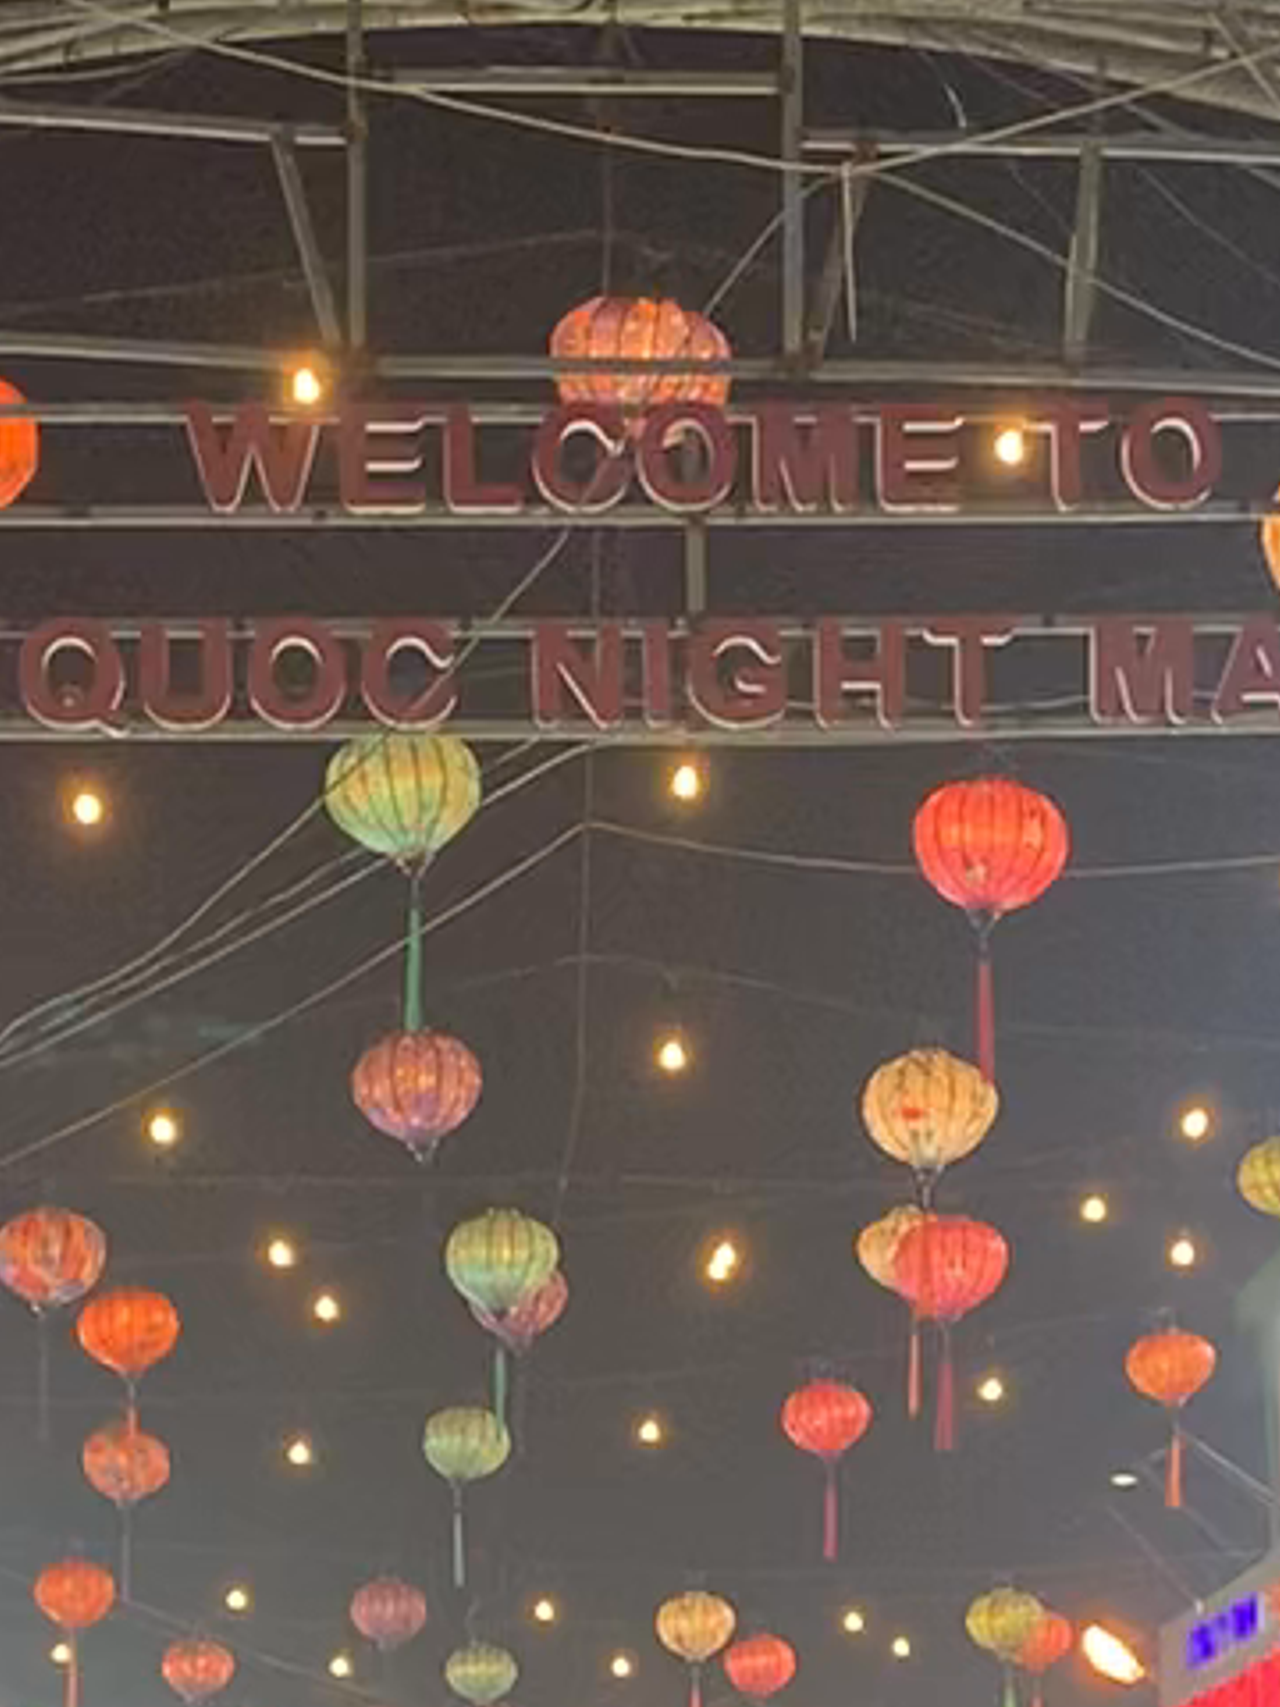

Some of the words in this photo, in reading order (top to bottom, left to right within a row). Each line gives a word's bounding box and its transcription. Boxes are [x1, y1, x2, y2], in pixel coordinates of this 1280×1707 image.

[183, 399, 961, 515] WELCOME
[1018, 397, 1223, 513] TO
[17, 617, 460, 736] QUOC
[529, 615, 1022, 731] NIGHT
